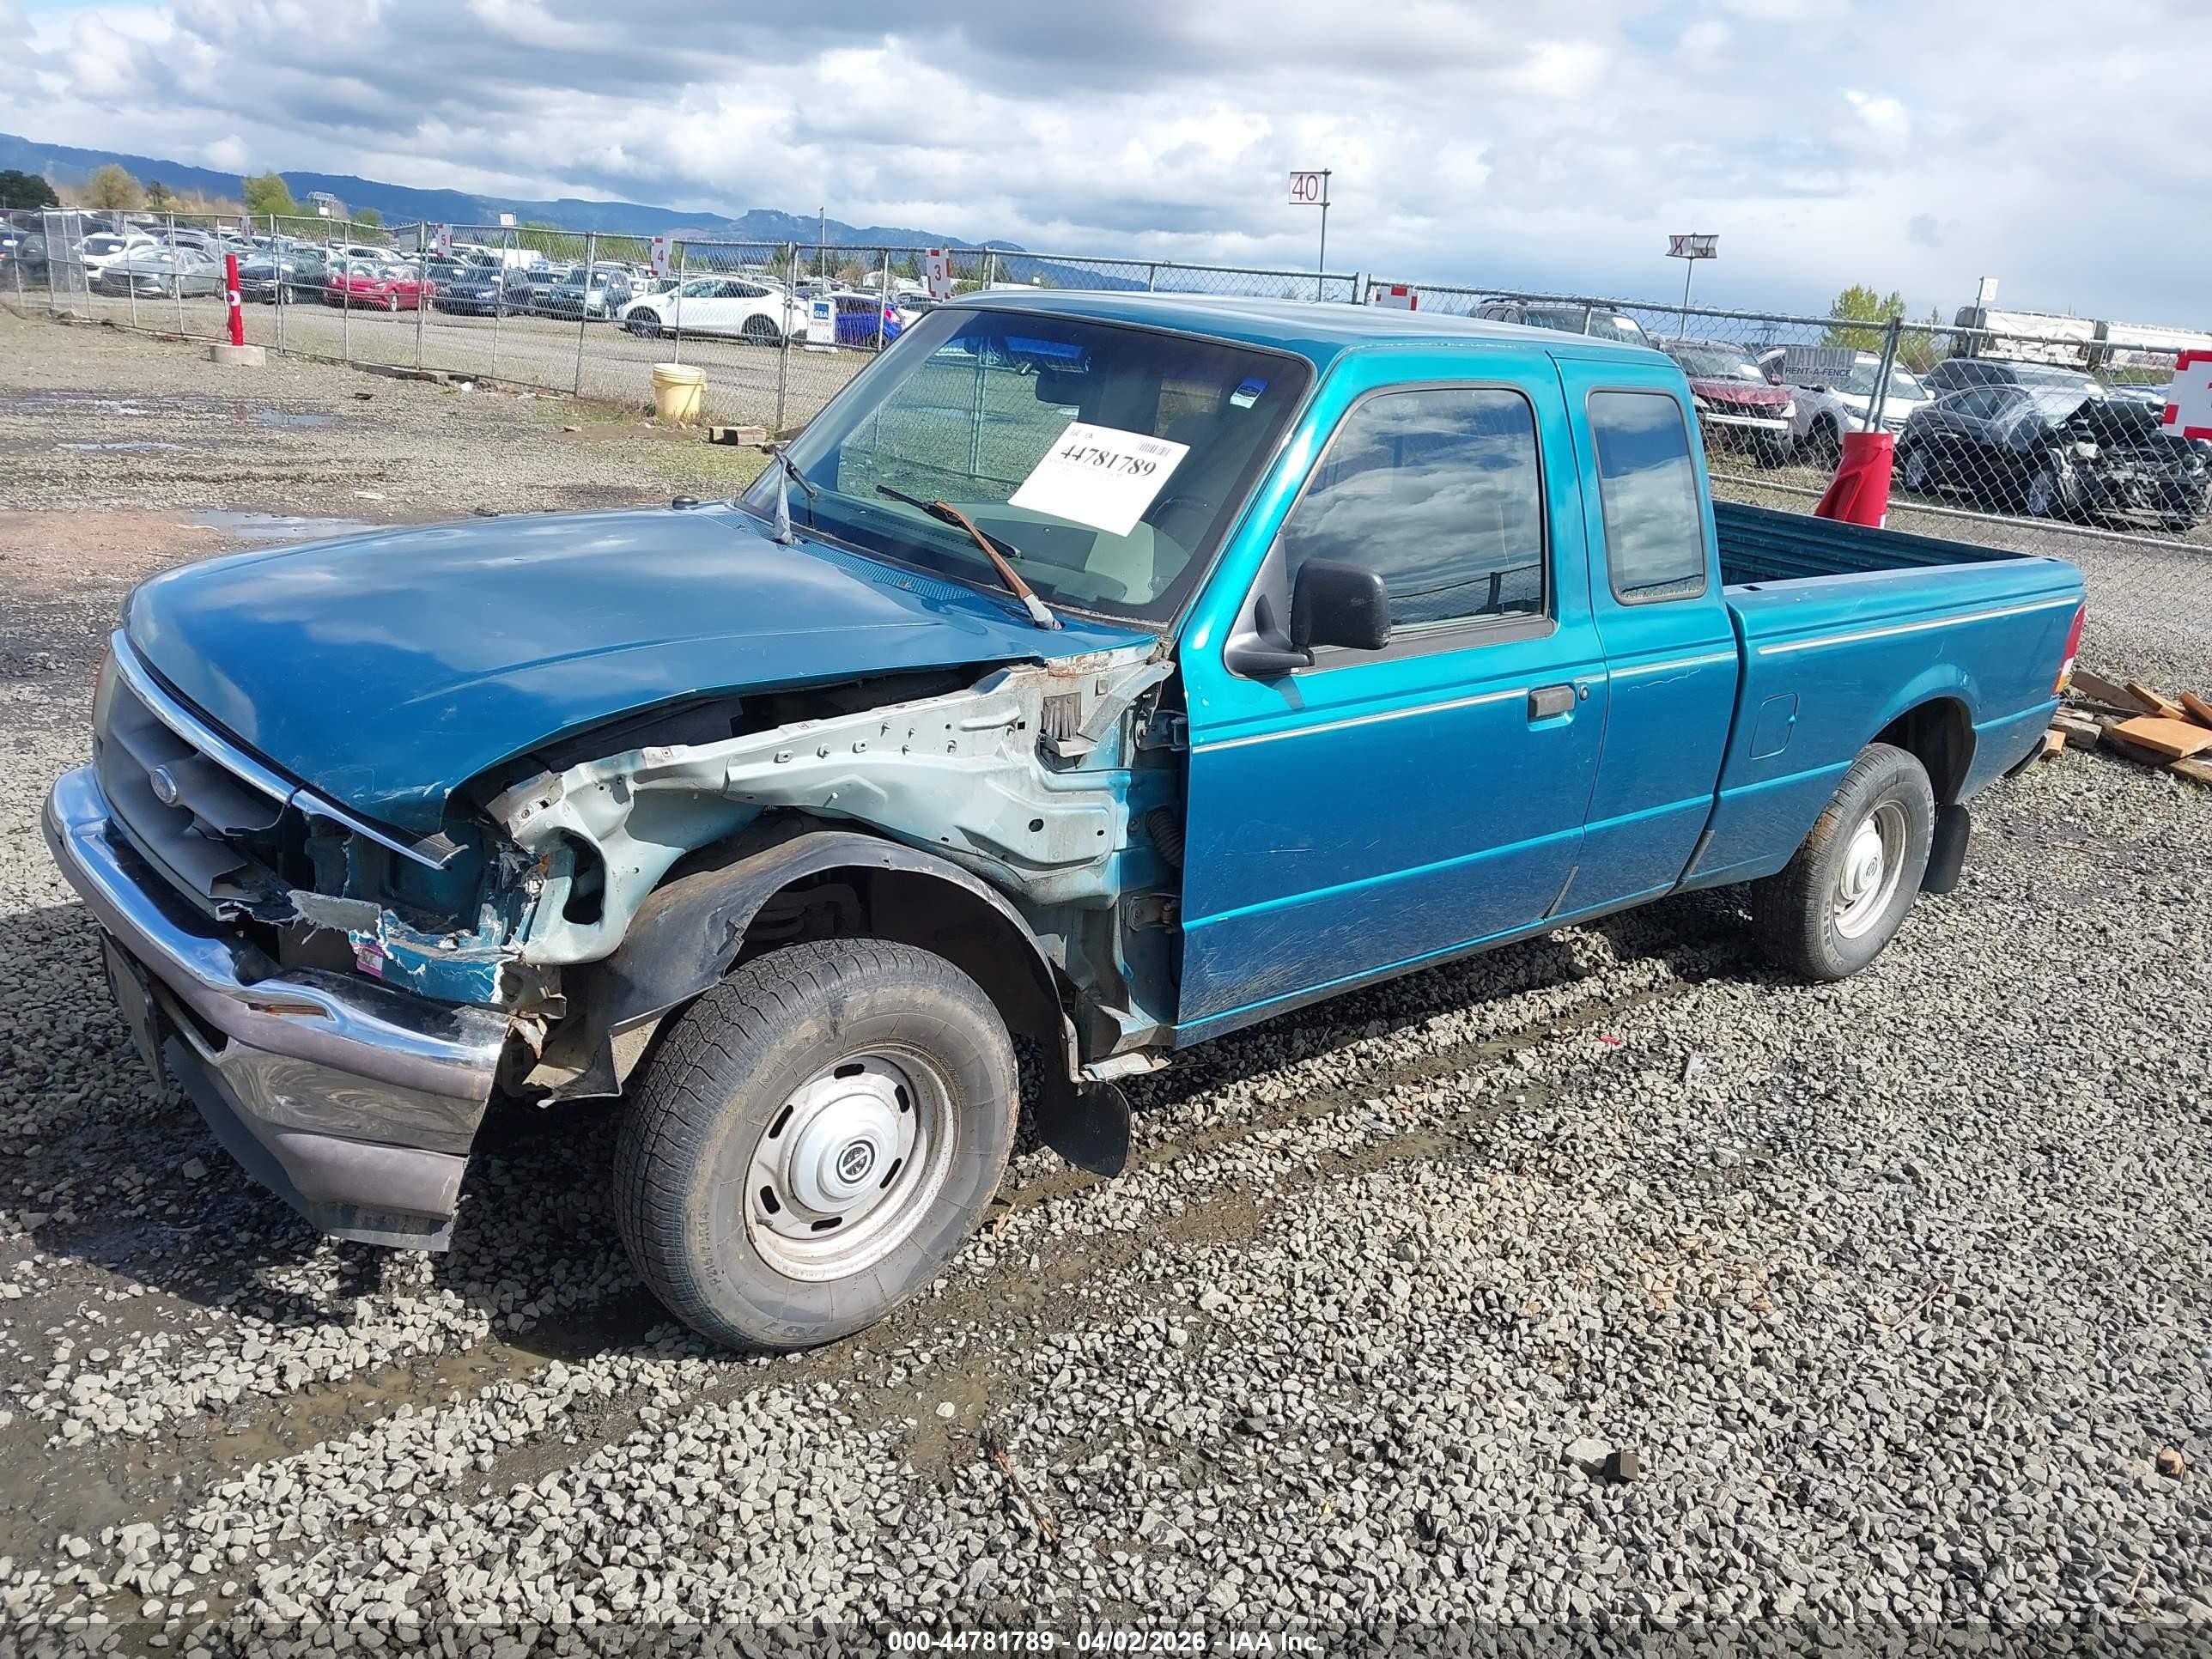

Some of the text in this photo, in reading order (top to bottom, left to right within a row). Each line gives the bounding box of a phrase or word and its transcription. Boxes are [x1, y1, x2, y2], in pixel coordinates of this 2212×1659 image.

[1291, 174, 1318, 201] 40
[441, 234, 447, 246] 5
[657, 249, 665, 264] 4
[933, 264, 942, 282] 3
[1786, 347, 1854, 368] NATIONAL
[1784, 366, 1851, 378] RENT-A-FENCE
[1060, 445, 1157, 477] 44781789
